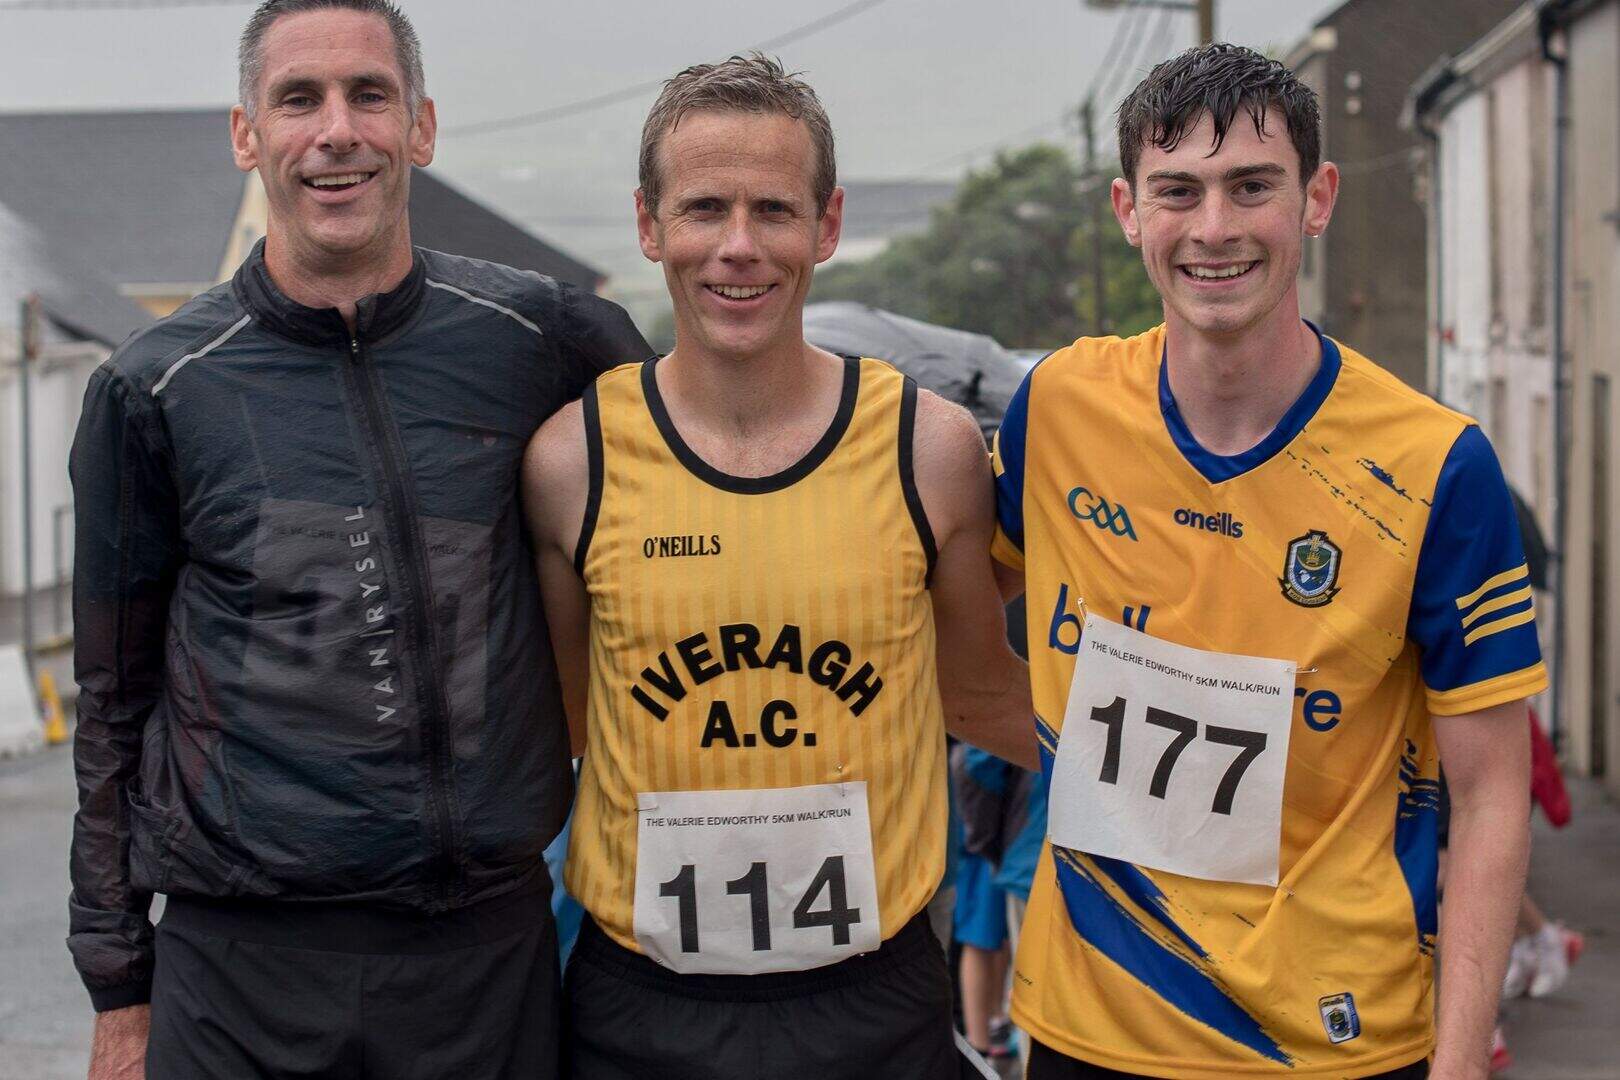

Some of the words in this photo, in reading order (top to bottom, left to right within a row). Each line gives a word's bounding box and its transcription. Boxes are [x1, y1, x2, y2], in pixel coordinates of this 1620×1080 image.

[344, 506, 385, 623] RYSEL
[643, 534, 721, 559] O'NEILLS
[369, 648, 396, 722] VAN
[630, 623, 884, 722] IVERAGH
[1091, 641, 1108, 654] THE
[1108, 647, 1143, 666] VALERIE
[1145, 658, 1194, 682] EDWORTHY
[1195, 676, 1218, 688] 5KM
[1220, 679, 1281, 696] WALK/RUN
[700, 700, 817, 748] A.C.
[1090, 696, 1268, 816] 177
[646, 818, 664, 827] THE
[666, 817, 705, 827] VALERIE
[707, 815, 769, 826] EDWORTHY
[771, 813, 795, 824] 5KM
[797, 808, 851, 822] WALK/RUN
[659, 855, 860, 953] 114
